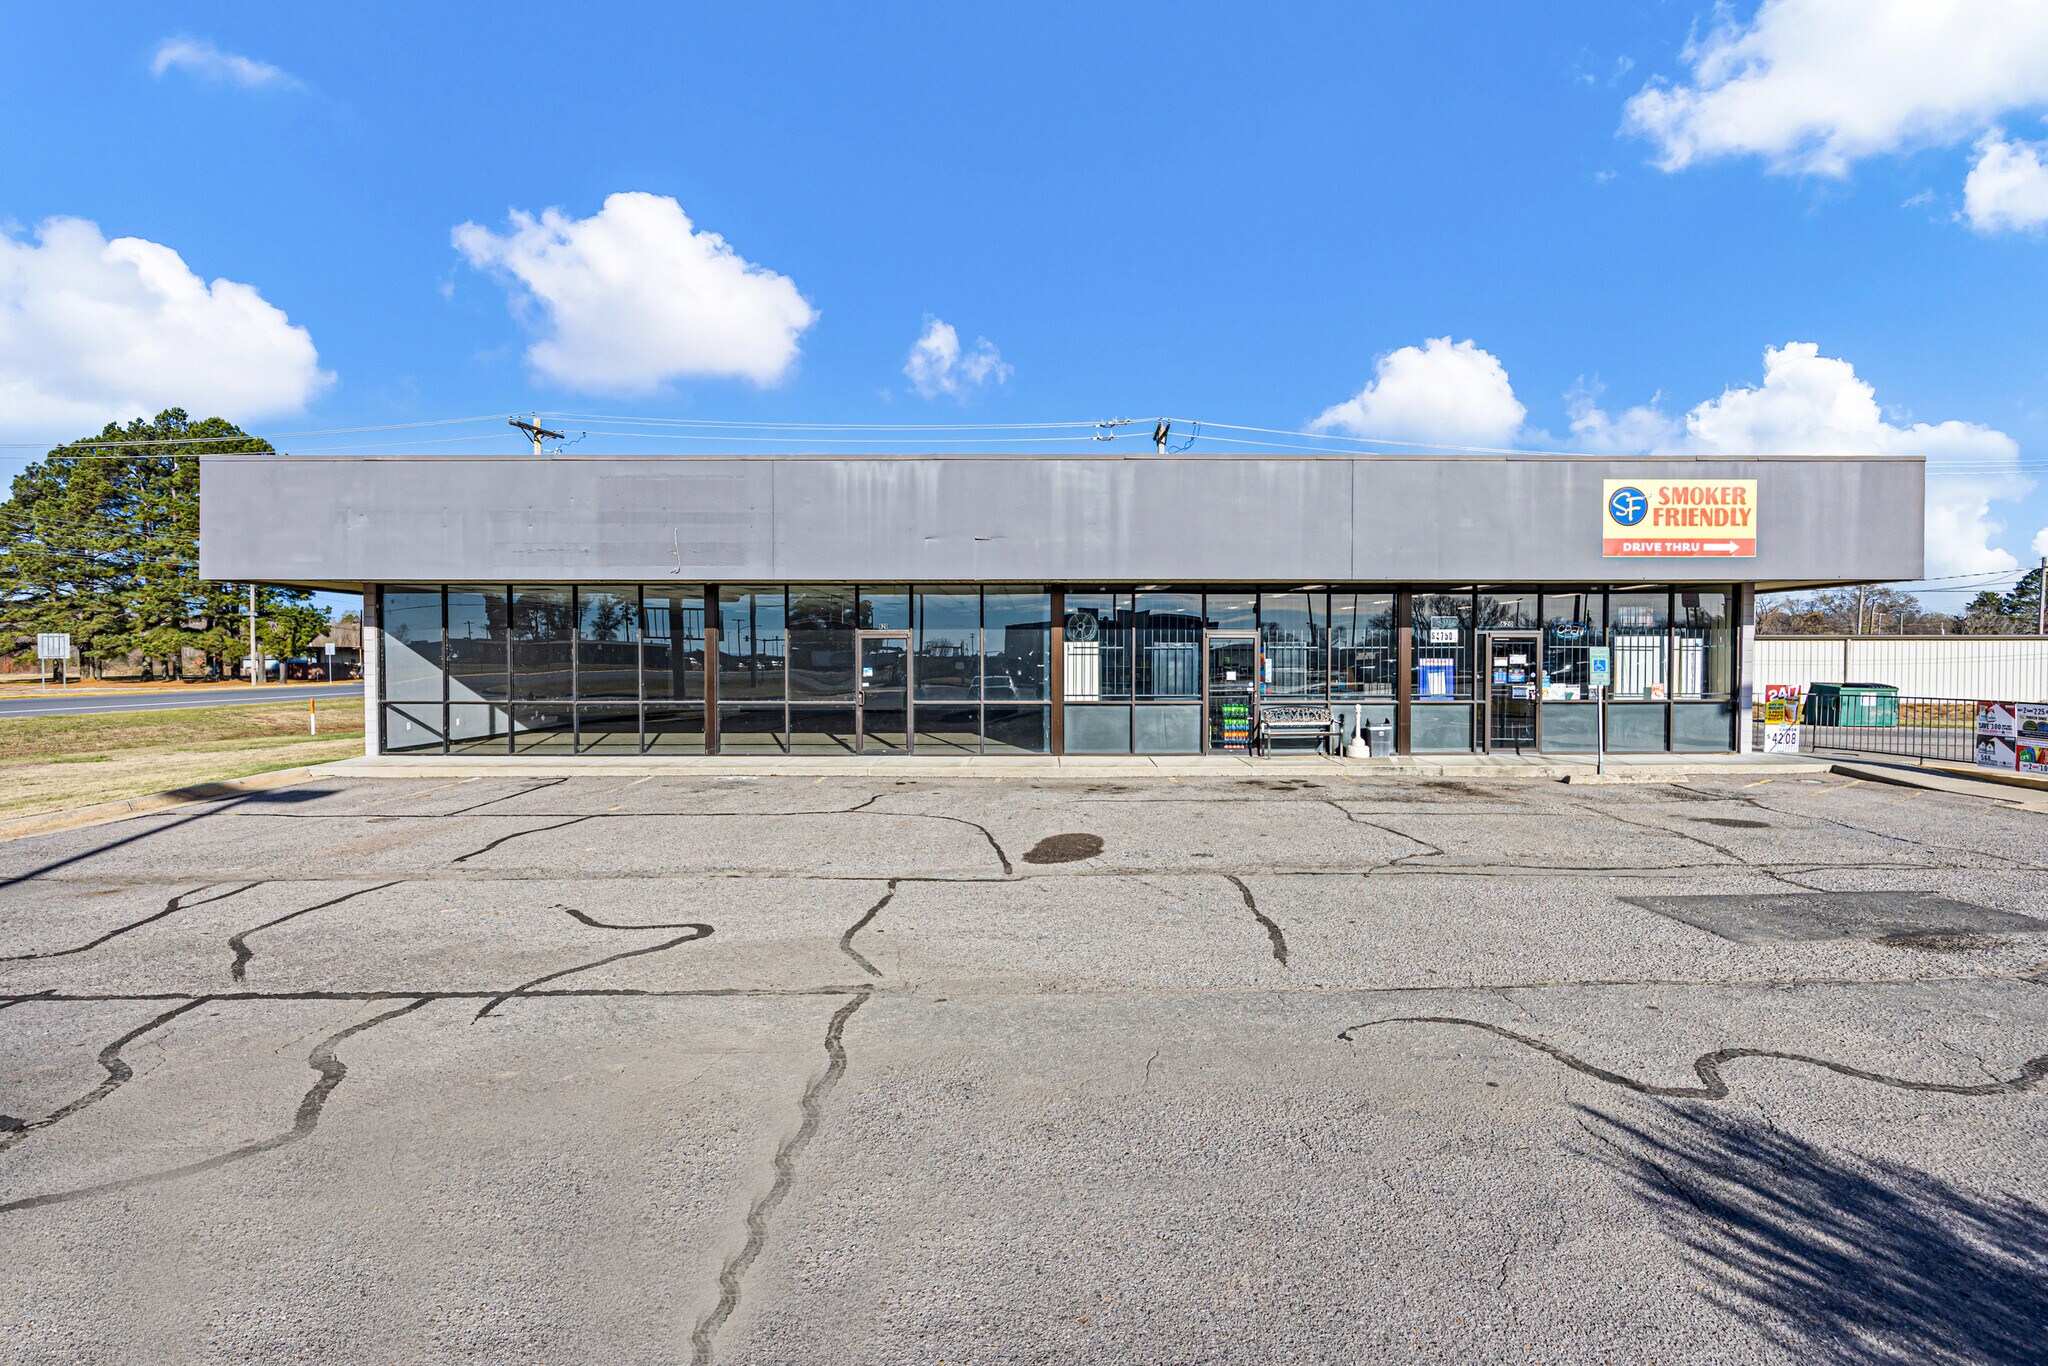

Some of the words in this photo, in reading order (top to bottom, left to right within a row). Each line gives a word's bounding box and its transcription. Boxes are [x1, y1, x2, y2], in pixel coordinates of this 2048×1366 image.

[1658, 486, 1747, 506] SMOKER
[1612, 491, 1648, 522] SF
[1653, 507, 1751, 527] FRIENDLY
[1623, 542, 1662, 552] DRIVE
[1665, 542, 1700, 552] THRU
